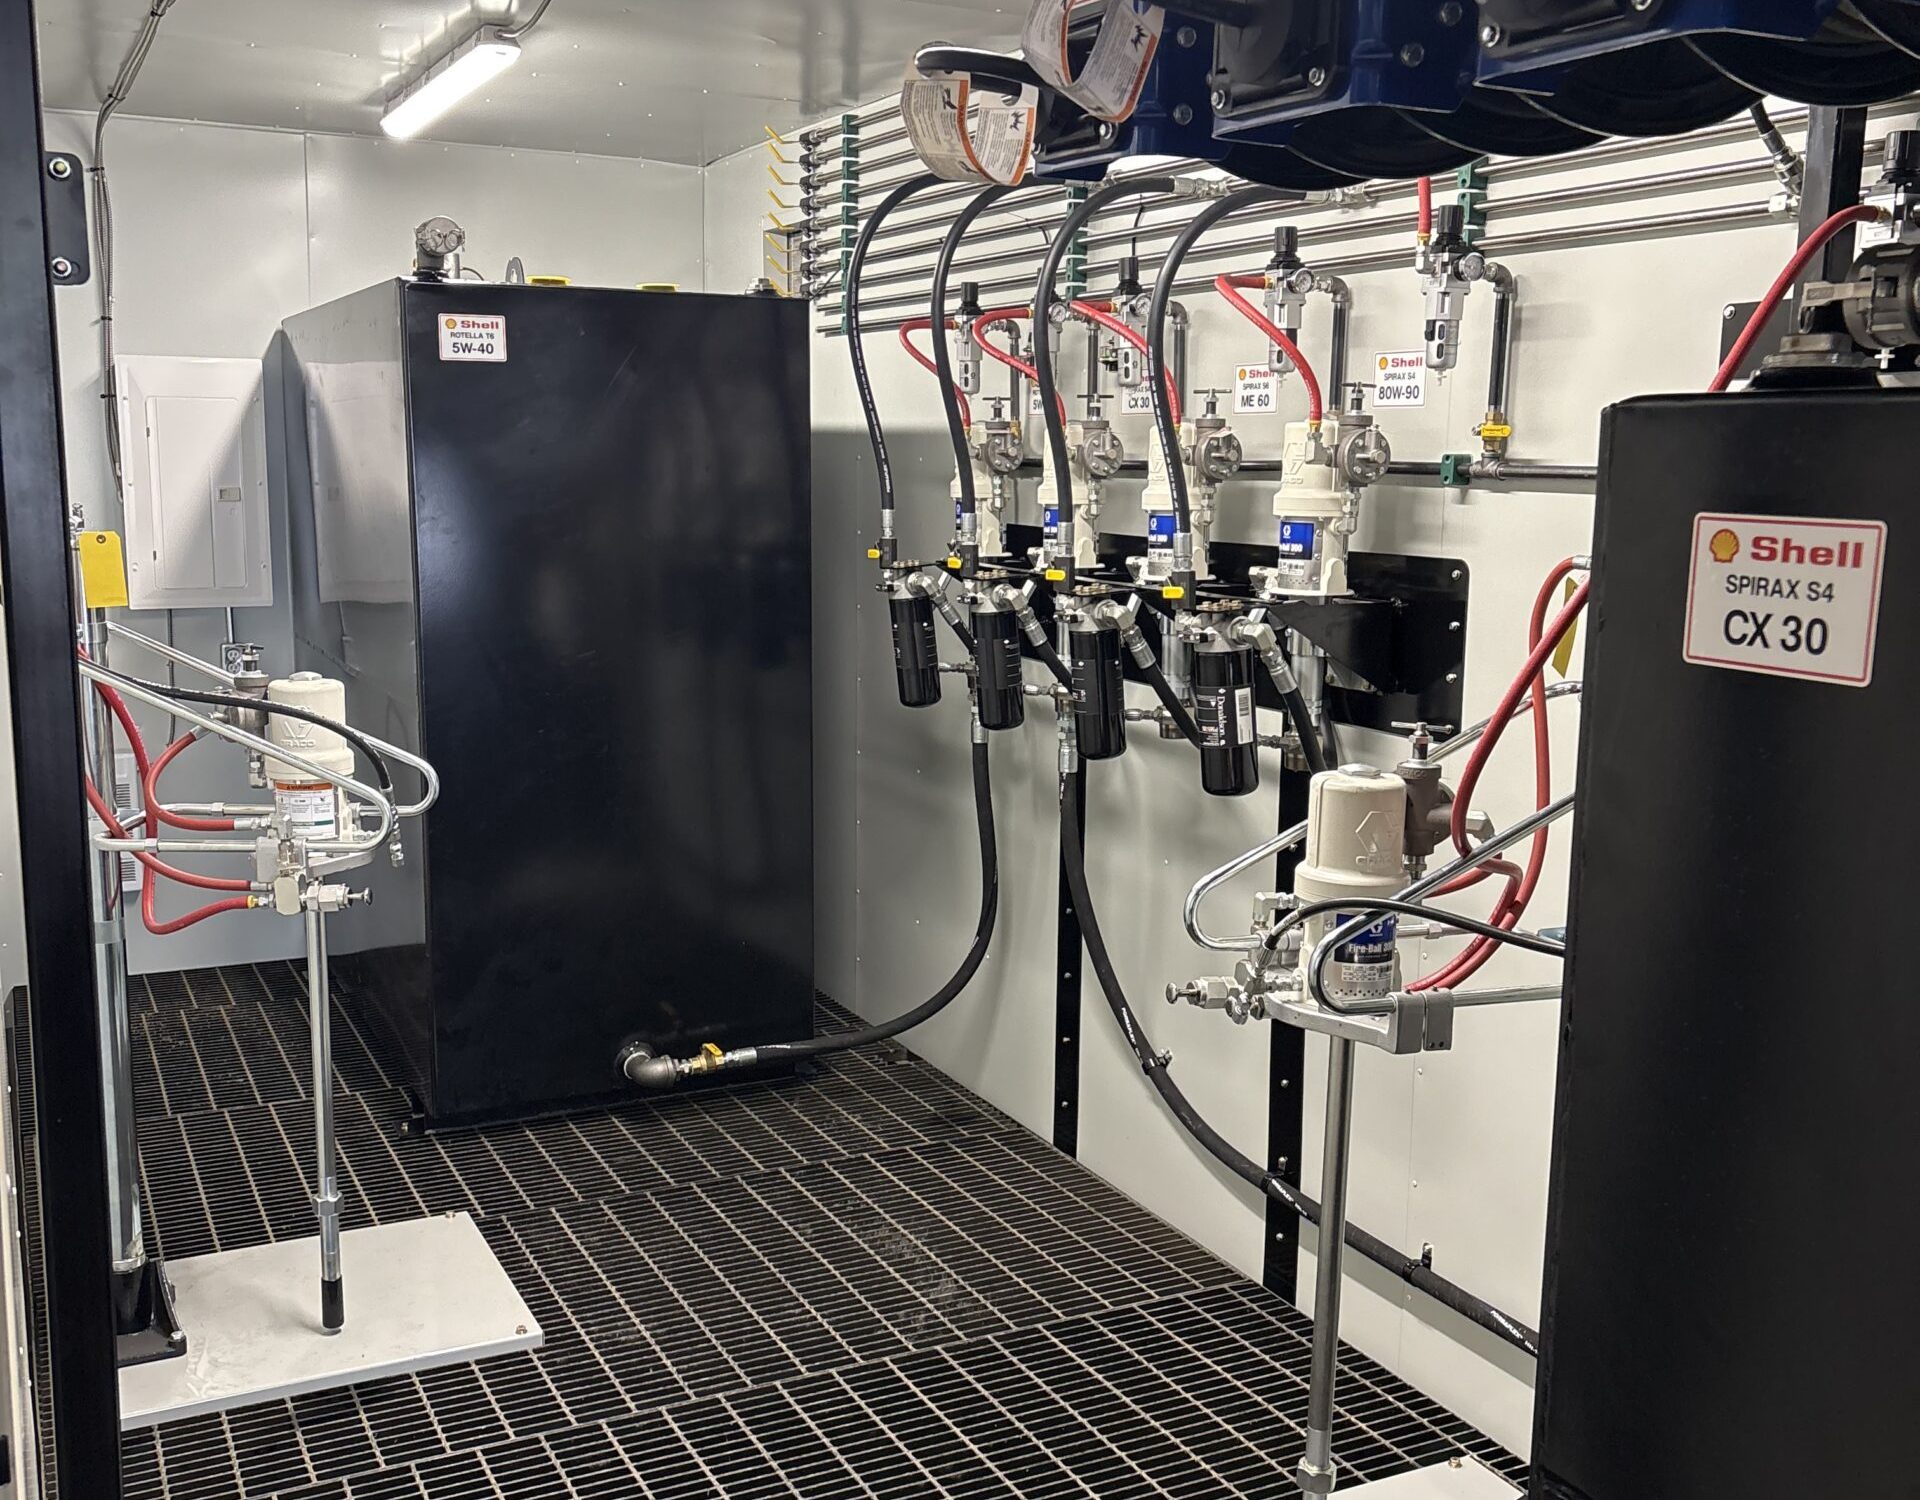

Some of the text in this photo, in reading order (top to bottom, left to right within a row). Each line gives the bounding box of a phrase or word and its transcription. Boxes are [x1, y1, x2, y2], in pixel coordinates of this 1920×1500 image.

[460, 320, 499, 329] Shell
[450, 331, 495, 340] ROTELLA T6
[452, 342, 494, 354] 5W-40
[1391, 356, 1423, 368] Shell
[1384, 371, 1416, 381] SPIRAX S4
[1378, 385, 1420, 400] 80W-90
[1128, 397, 1150, 409] CX 30
[1241, 393, 1270, 407] ME 60
[1750, 535, 1864, 569] Shell
[1725, 574, 1835, 603] SPIRAX S4
[1723, 609, 1828, 656] CX 30
[1217, 696, 1227, 735] Donaldson
[1348, 943, 1382, 954] Fire-Ball
